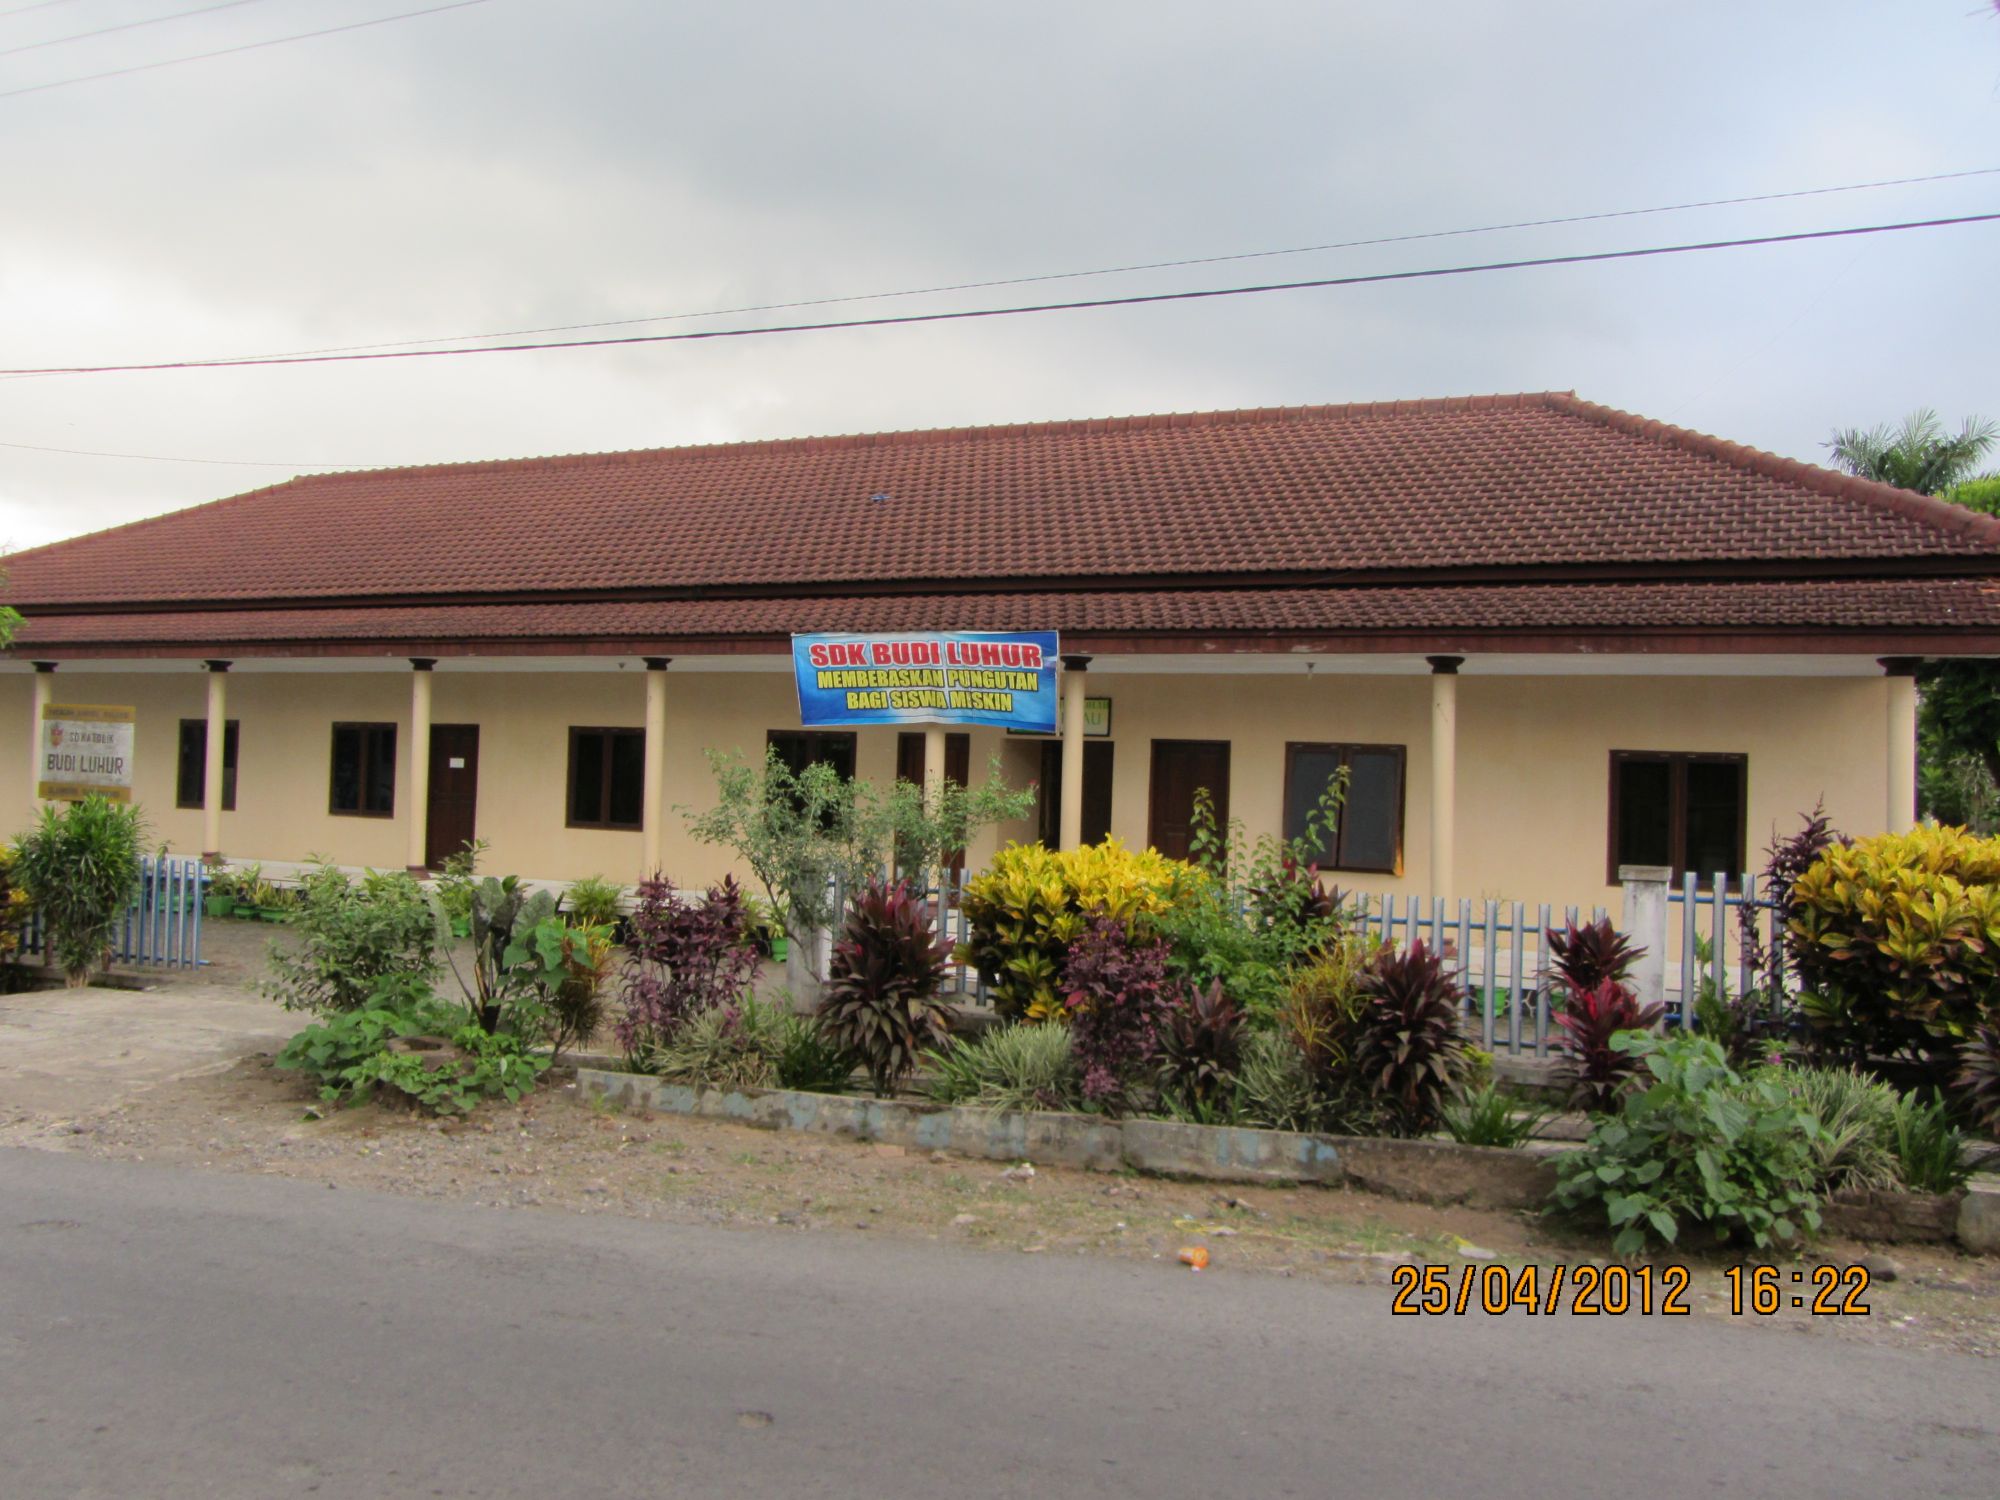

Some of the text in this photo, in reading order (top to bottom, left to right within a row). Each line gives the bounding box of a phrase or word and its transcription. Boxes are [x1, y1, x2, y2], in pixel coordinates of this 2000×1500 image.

[810, 642, 1043, 668] SDK BUDI LUHUR
[817, 670, 1038, 691] MEMBEBASKAN PUNGUTAN
[847, 691, 1012, 712] BAGI SISWA MISKIN
[47, 753, 124, 775] BUDI LUHUR
